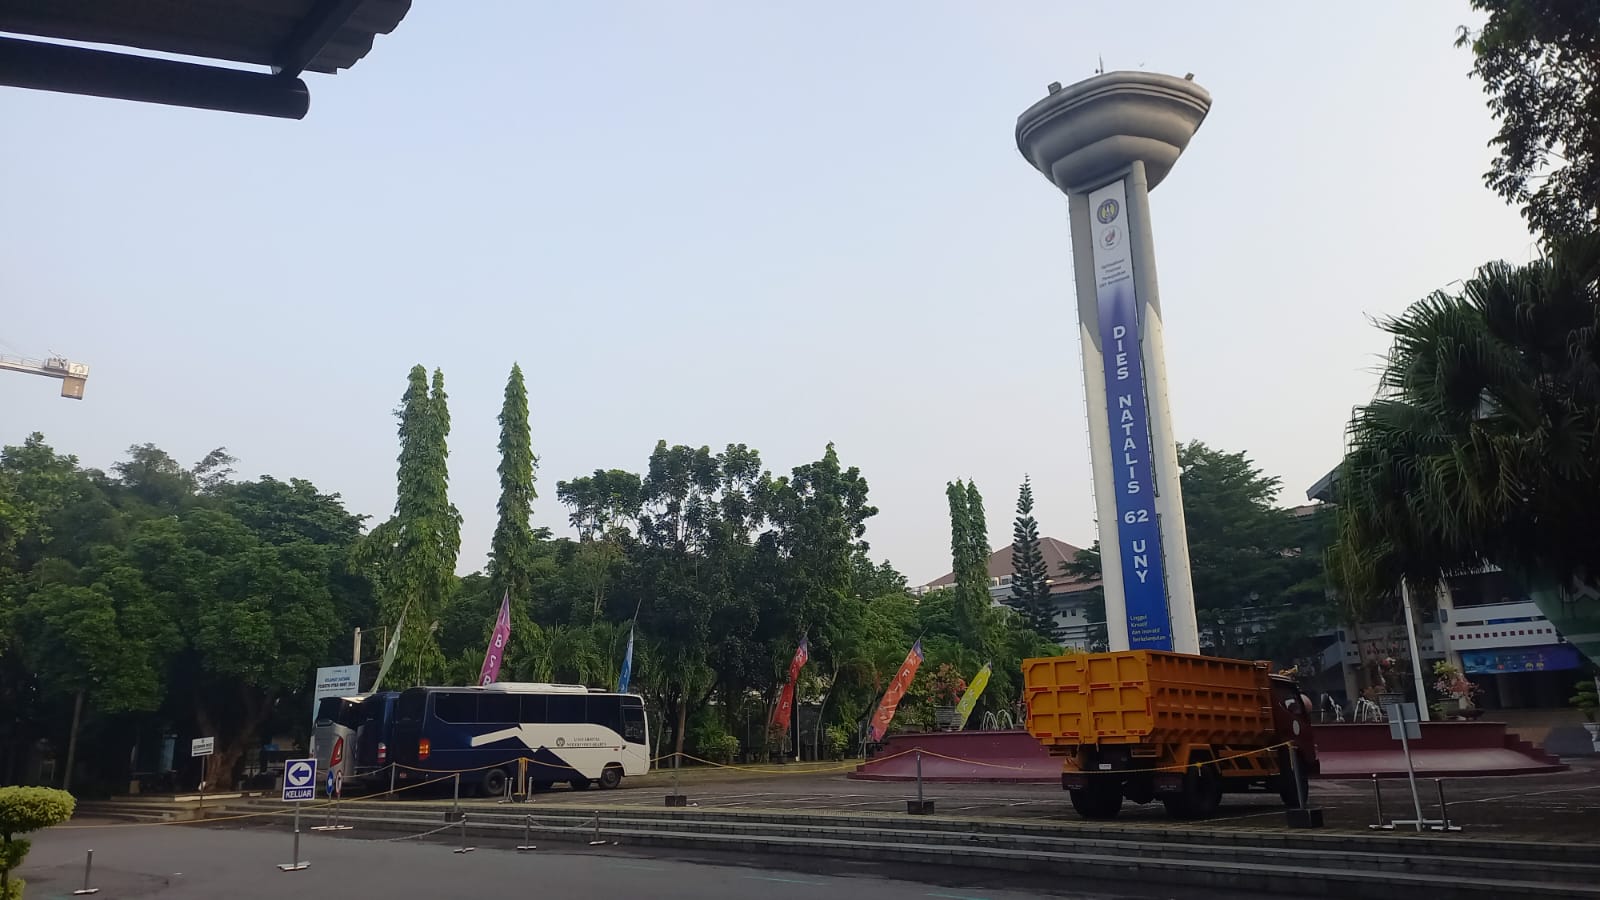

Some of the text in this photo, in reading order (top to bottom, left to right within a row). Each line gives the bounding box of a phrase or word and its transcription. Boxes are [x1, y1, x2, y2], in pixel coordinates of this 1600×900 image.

[1113, 325, 1149, 583] DIES NATALIS 62 UNY
[285, 789, 313, 799] KELUAR
